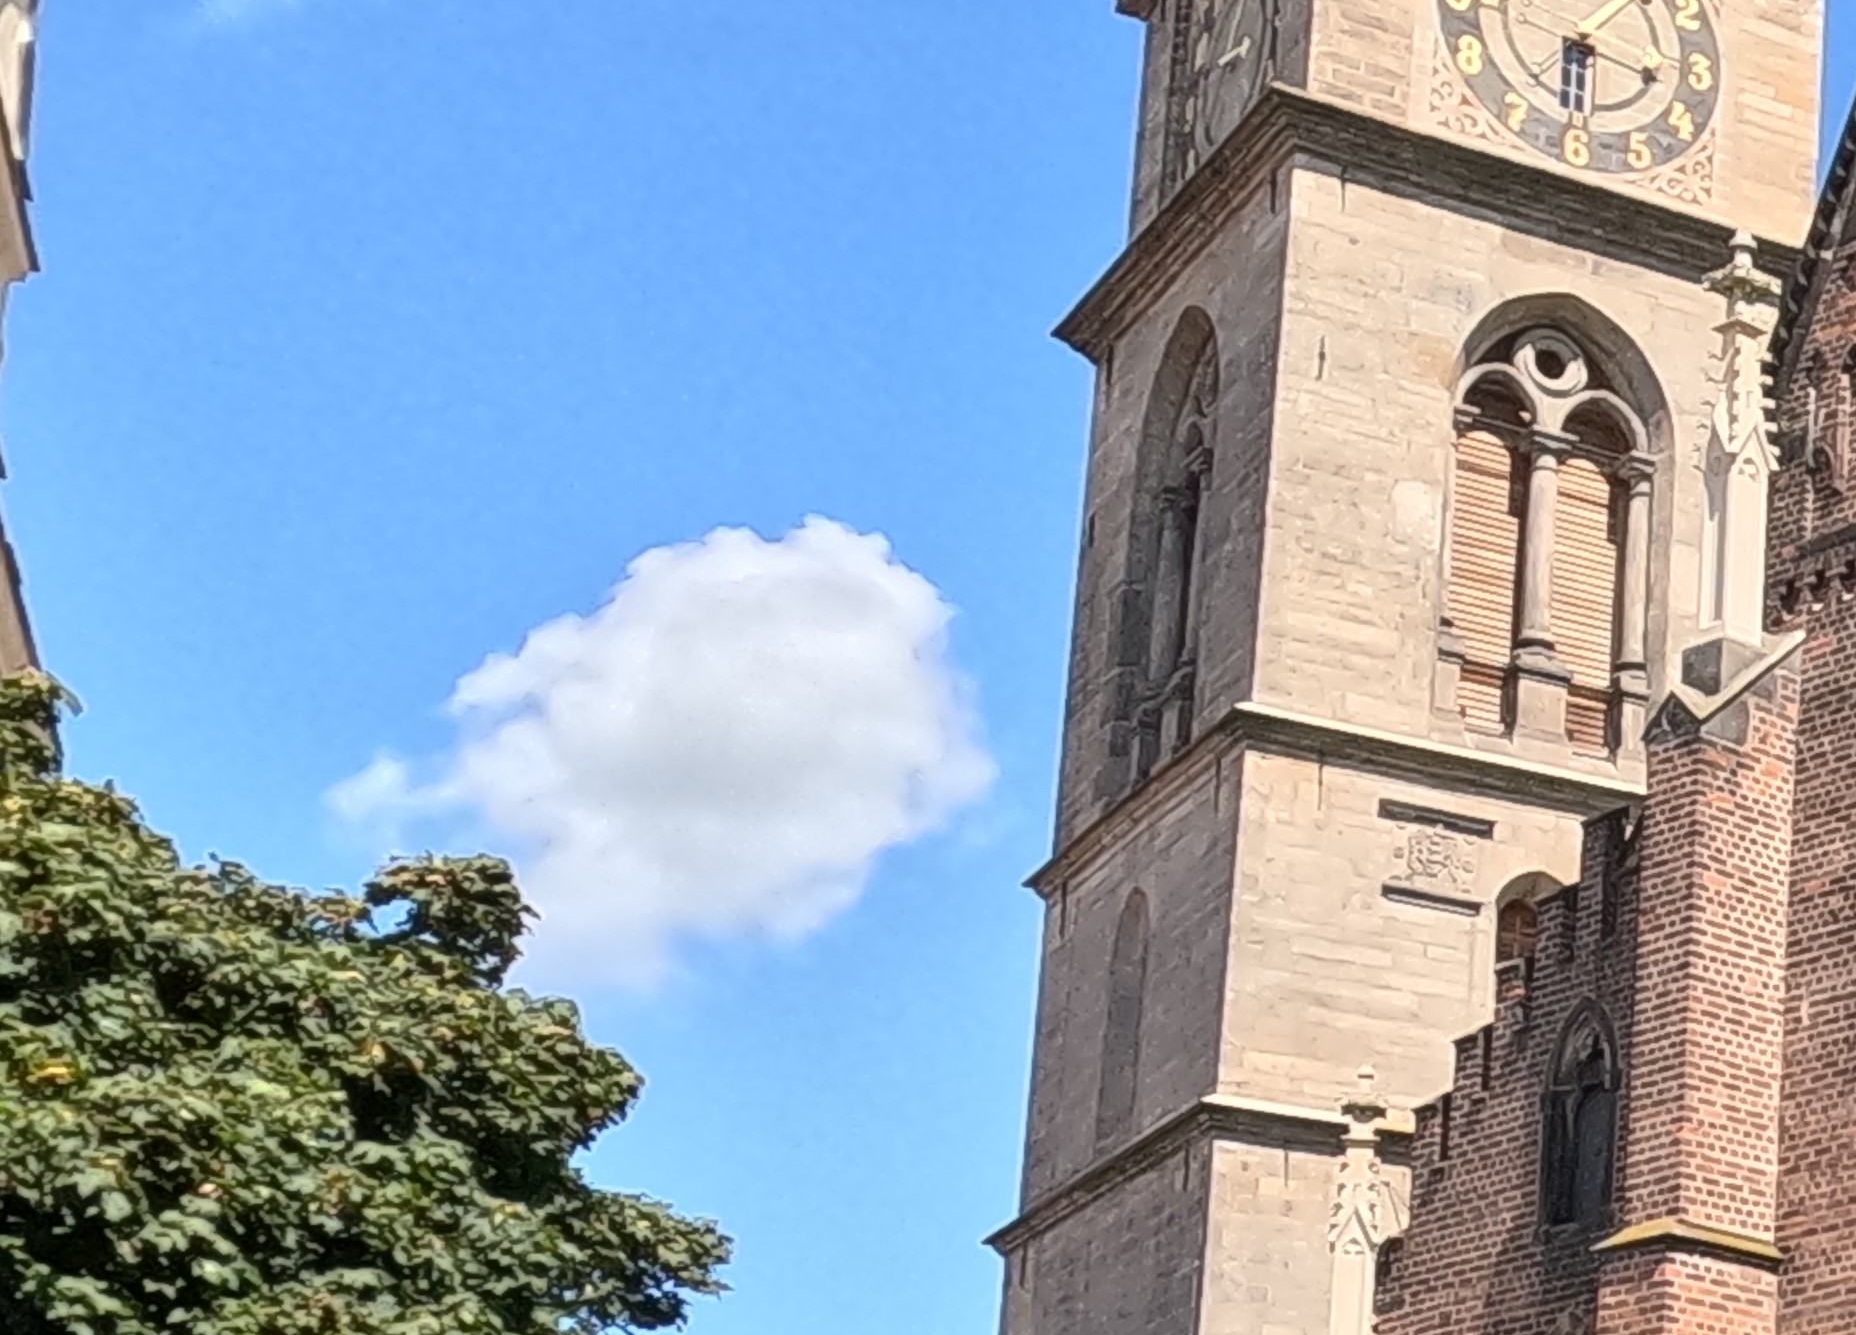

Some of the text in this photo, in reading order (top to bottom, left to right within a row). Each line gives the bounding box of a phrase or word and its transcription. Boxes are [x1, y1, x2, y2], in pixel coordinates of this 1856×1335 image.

[1456, 34, 1483, 76] 8
[1687, 52, 1712, 92] 3
[1504, 92, 1529, 132] 7
[1668, 100, 1694, 142] 4
[1564, 128, 1591, 165] 6
[1627, 131, 1652, 170] 5
